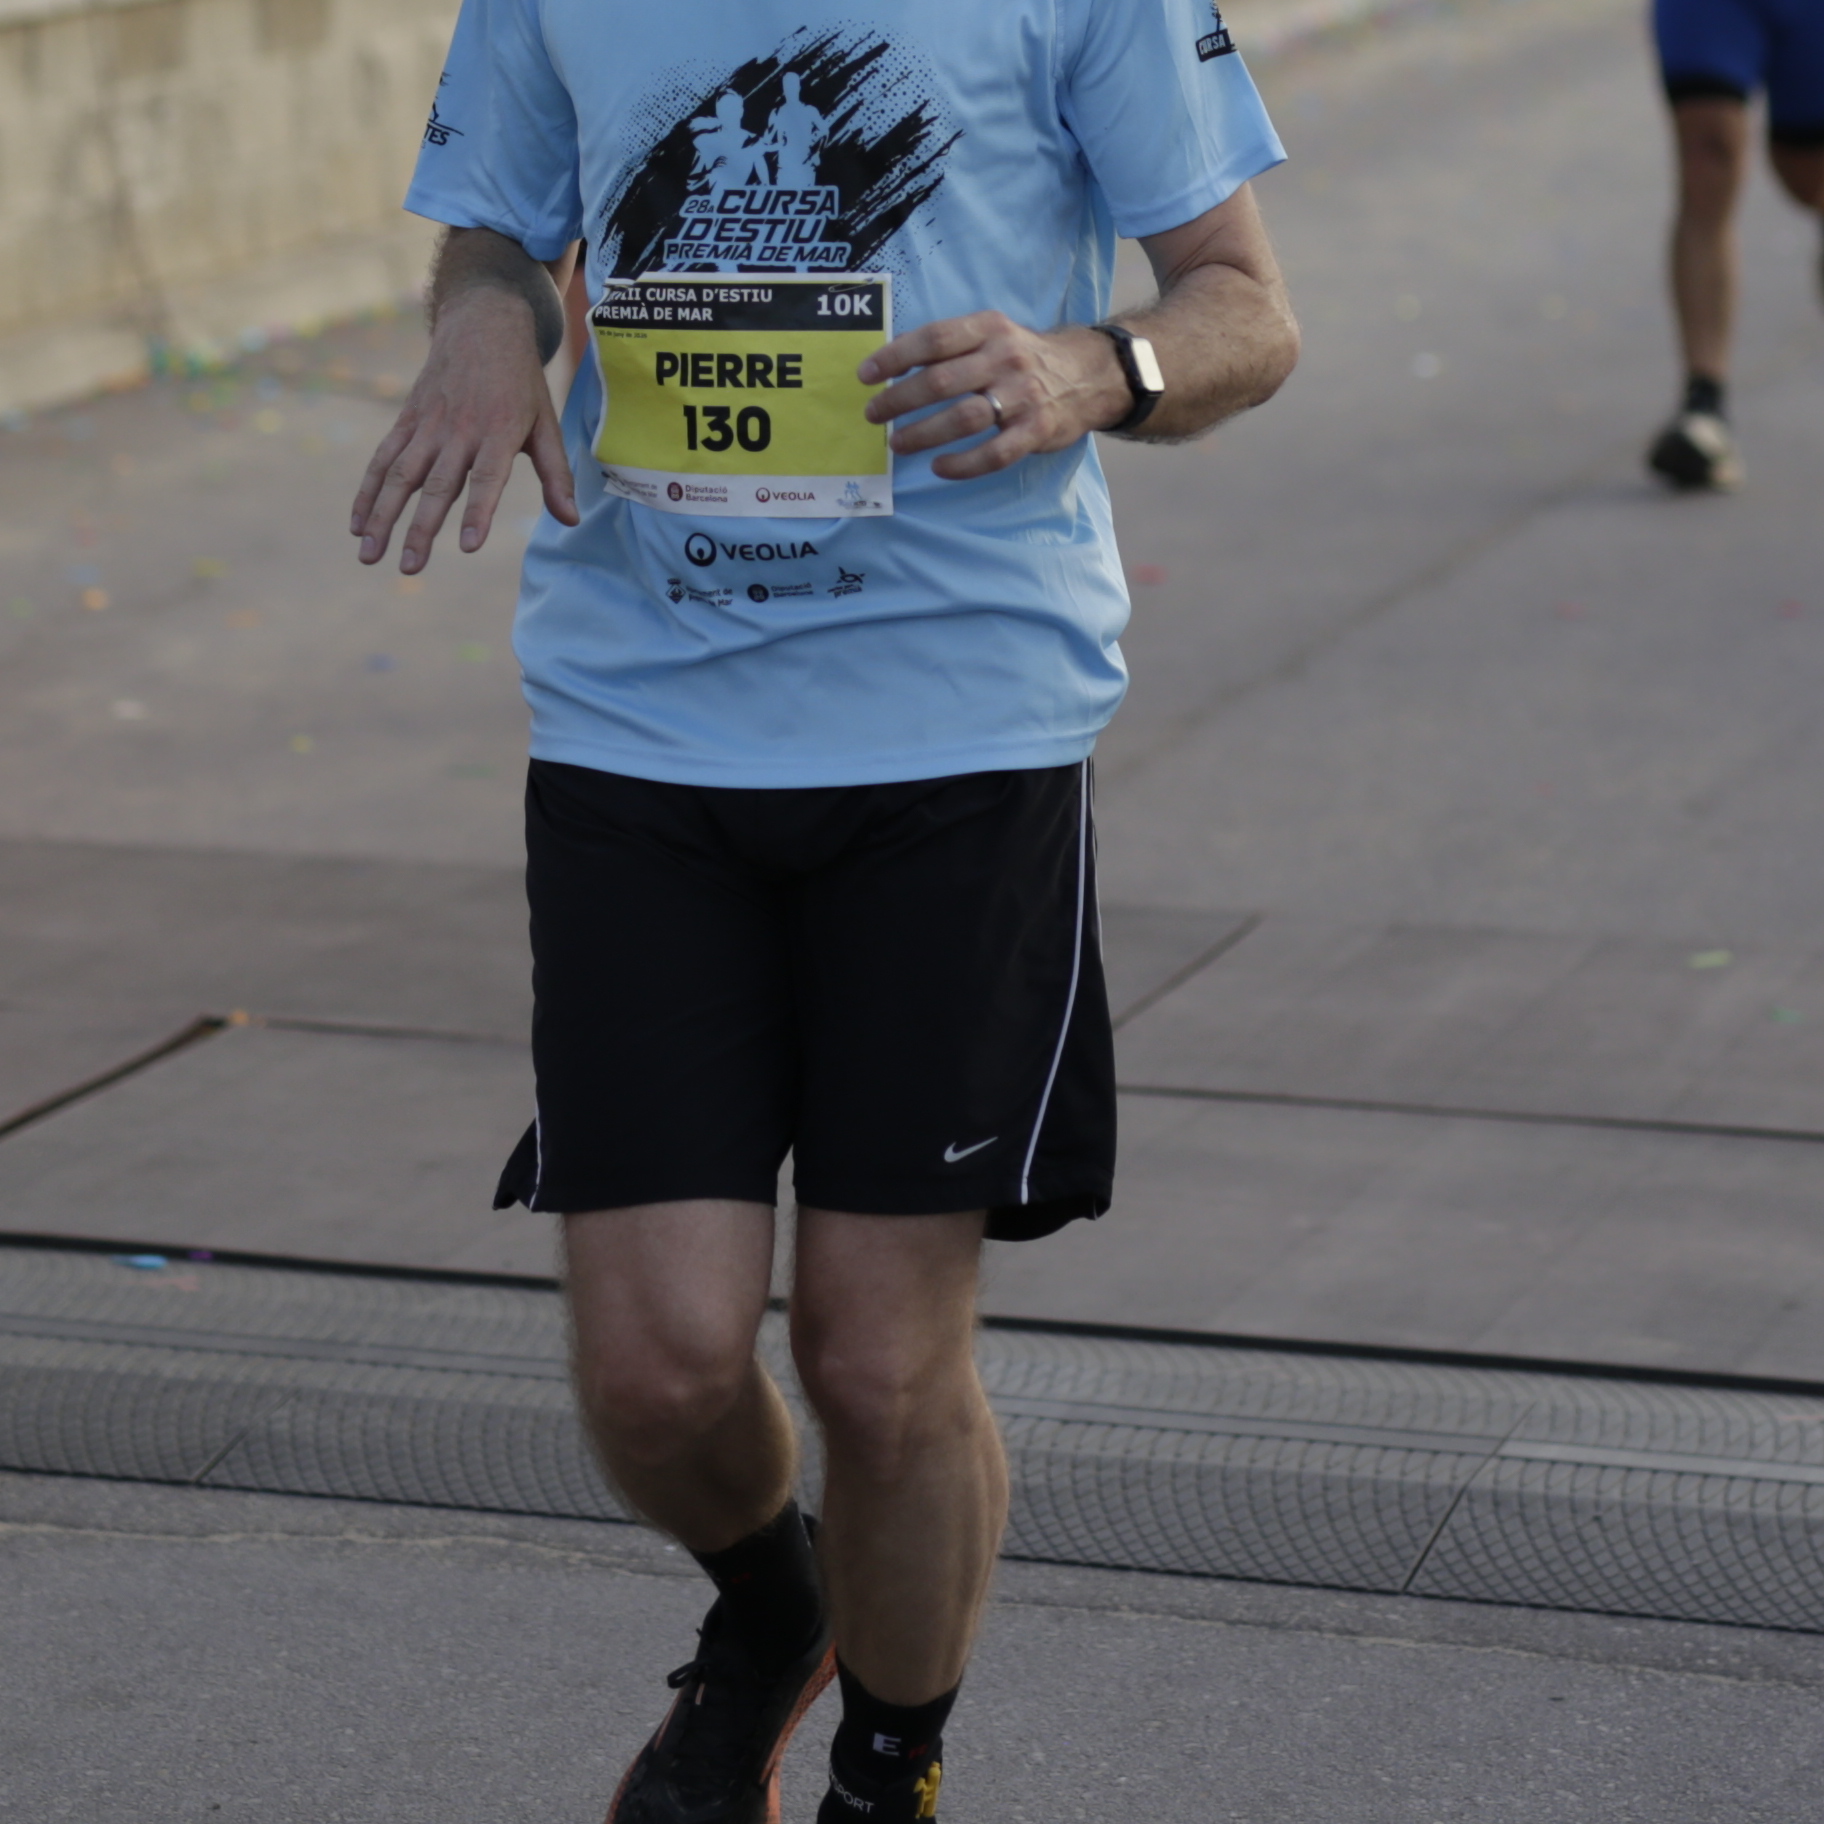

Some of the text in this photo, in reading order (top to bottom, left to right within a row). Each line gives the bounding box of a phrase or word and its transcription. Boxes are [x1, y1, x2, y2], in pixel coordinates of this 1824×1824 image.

[716, 189, 837, 215] CURSA
[680, 218, 824, 244] D'ESTIU
[756, 245, 792, 261] DE
[793, 246, 848, 263] MAR
[595, 302, 714, 322] PREMIÀ DE MAR
[646, 287, 697, 303] CURSA
[702, 288, 773, 303] D'ESTIU
[816, 293, 873, 317] 10K
[656, 351, 803, 388] PIERRE
[683, 404, 771, 452] 130
[772, 491, 816, 501] VEOLIA
[720, 541, 819, 561] VEOLIA
